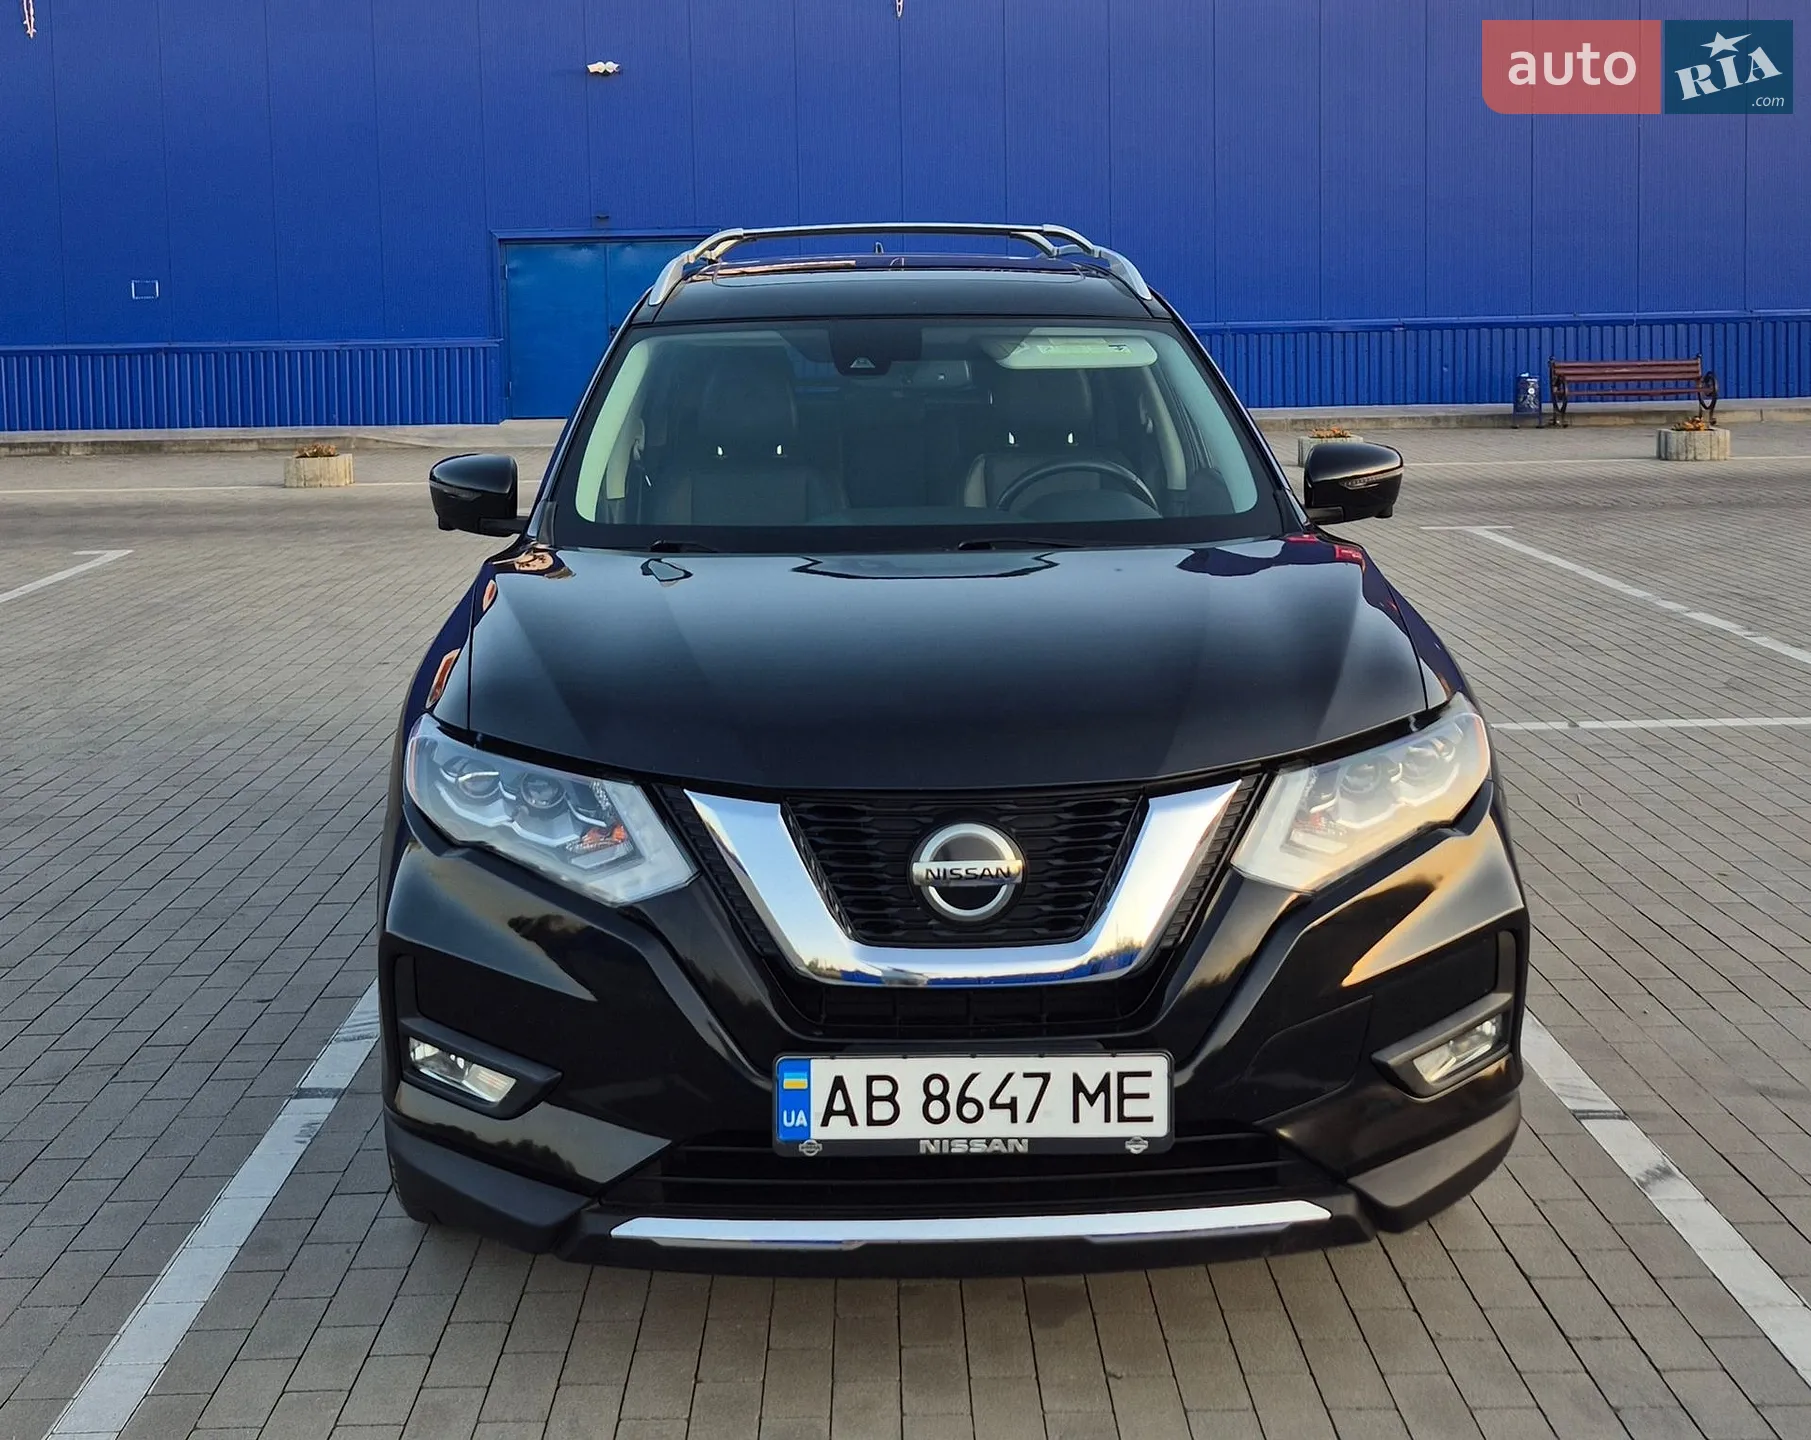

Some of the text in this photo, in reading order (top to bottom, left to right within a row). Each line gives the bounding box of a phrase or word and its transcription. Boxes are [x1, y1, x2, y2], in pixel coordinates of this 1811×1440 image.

[925, 865, 1011, 881] NISSAN
[820, 1070, 1154, 1127] AB 8647 ME
[783, 1109, 808, 1128] UA
[919, 1138, 1029, 1154] NISSAN
